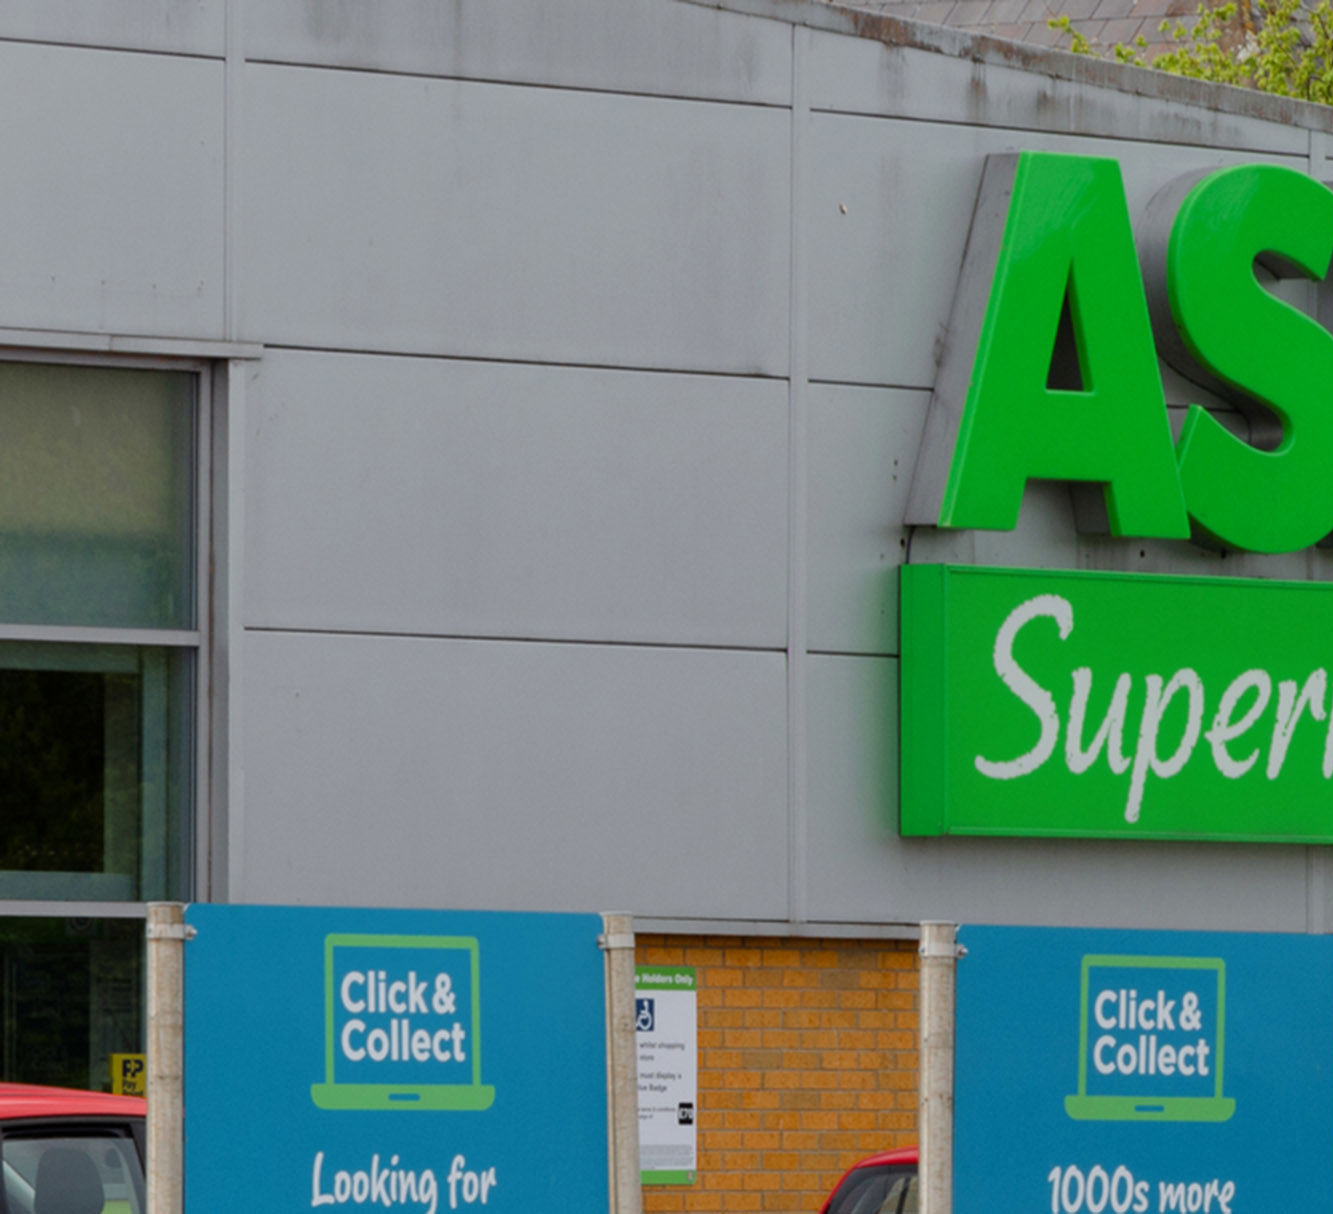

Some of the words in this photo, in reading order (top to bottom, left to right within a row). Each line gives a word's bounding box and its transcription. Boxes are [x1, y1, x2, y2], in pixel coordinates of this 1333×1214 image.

[340, 970, 429, 1014] Click
[432, 972, 456, 1015] &
[642, 974, 673, 984] Holders
[674, 974, 693, 987] Only
[1093, 989, 1177, 1031] Click
[1178, 991, 1203, 1032] &
[340, 1018, 466, 1063] Collect
[1093, 1034, 1211, 1076] Collect
[311, 1150, 439, 1214] Looking
[446, 1154, 498, 1210] for
[1047, 1164, 1150, 1214] 1000s
[1158, 1178, 1236, 1214] more
